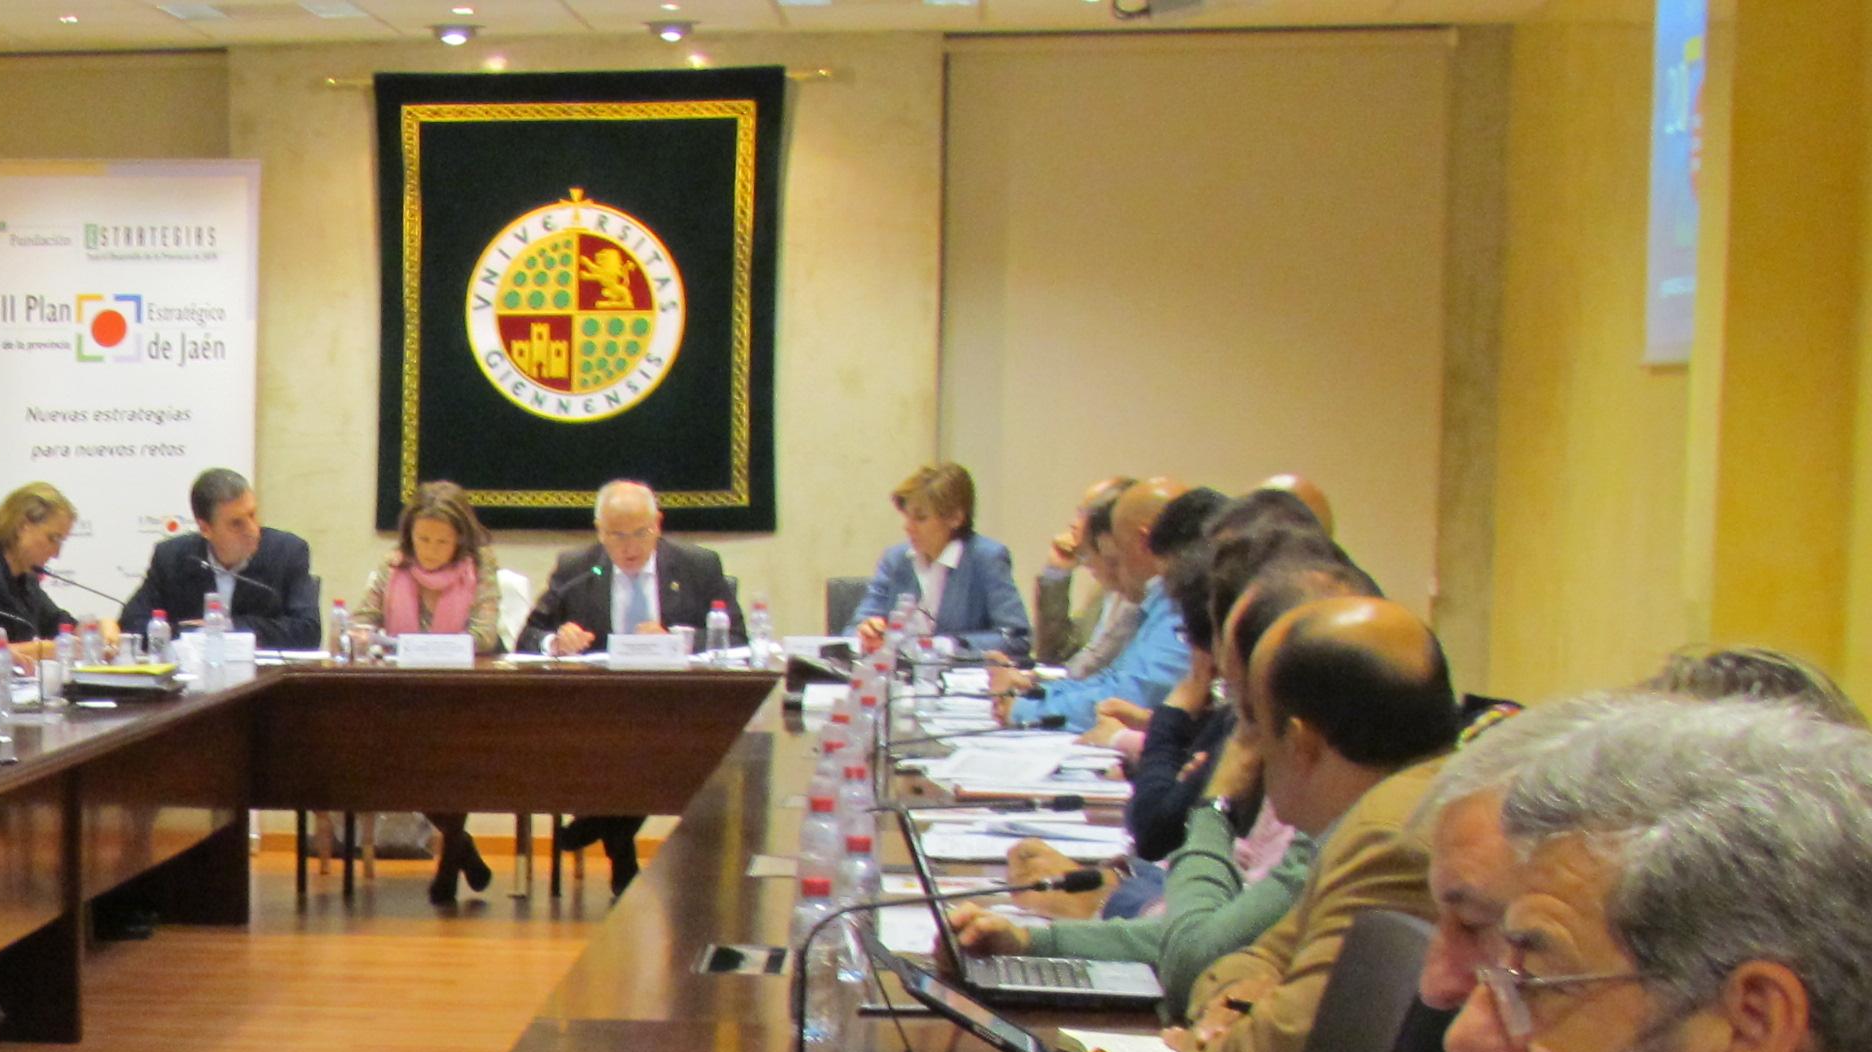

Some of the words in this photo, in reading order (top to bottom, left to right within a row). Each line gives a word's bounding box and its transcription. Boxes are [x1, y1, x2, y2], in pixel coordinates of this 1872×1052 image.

[1, 294, 16, 323] II
[25, 293, 72, 323] Plan
[147, 301, 227, 327] Estratégico
[1, 339, 13, 350] de
[27, 339, 70, 353] provincia
[147, 331, 172, 361] de
[177, 331, 226, 367] Jaén
[485, 350, 664, 415] GIENNENSIS
[25, 406, 88, 423] Nuevas
[92, 405, 192, 425] estrategias
[31, 445, 71, 463] para
[75, 445, 136, 458] nuevos
[140, 443, 186, 458] retos
